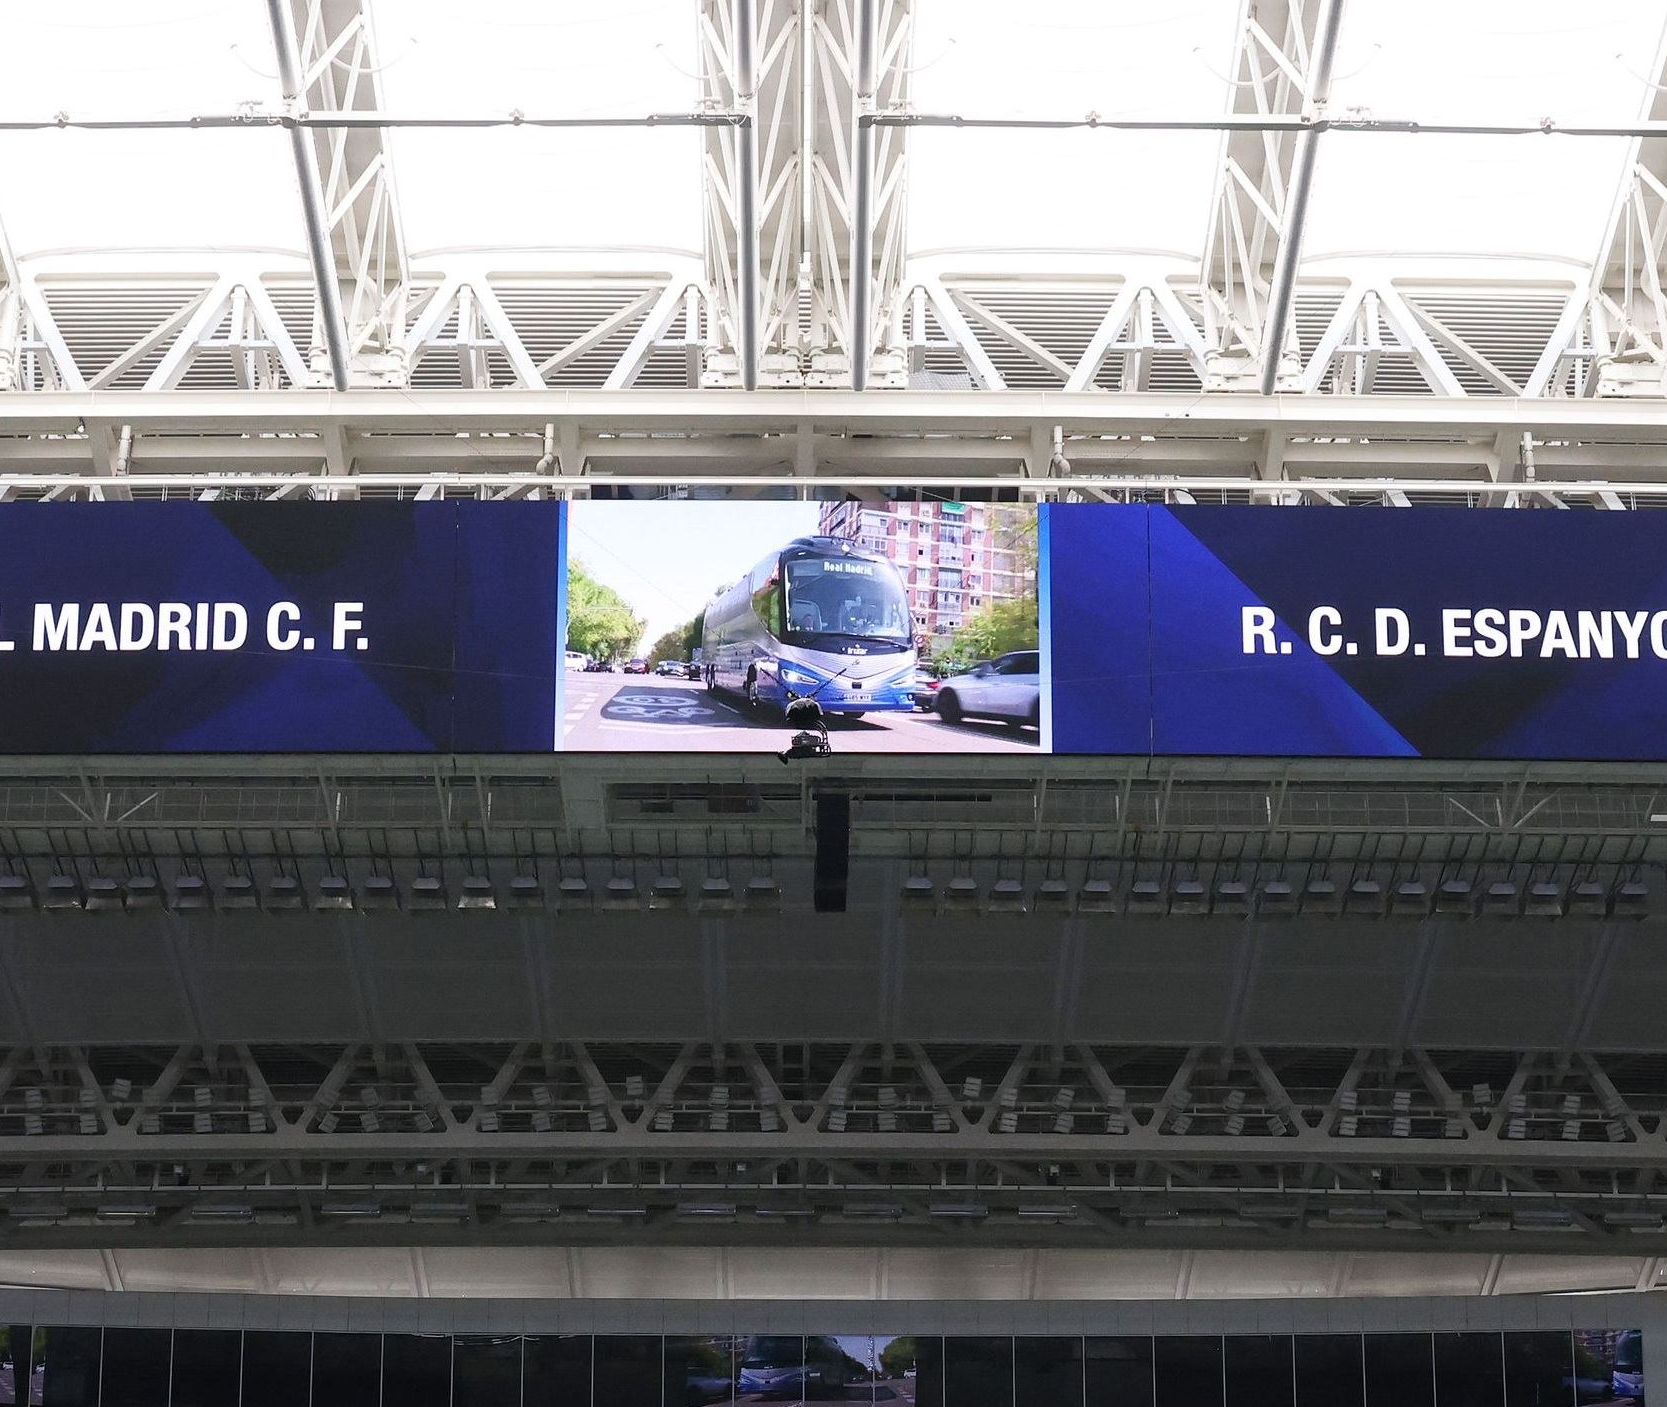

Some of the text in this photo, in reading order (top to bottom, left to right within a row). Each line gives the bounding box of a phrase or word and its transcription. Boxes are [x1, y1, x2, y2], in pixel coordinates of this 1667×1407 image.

[32, 602, 248, 651] MADRID
[266, 601, 315, 651] C.
[332, 602, 369, 650] F.
[1241, 606, 1292, 654] R.
[1308, 606, 1358, 655] C.
[1375, 607, 1426, 656] D.
